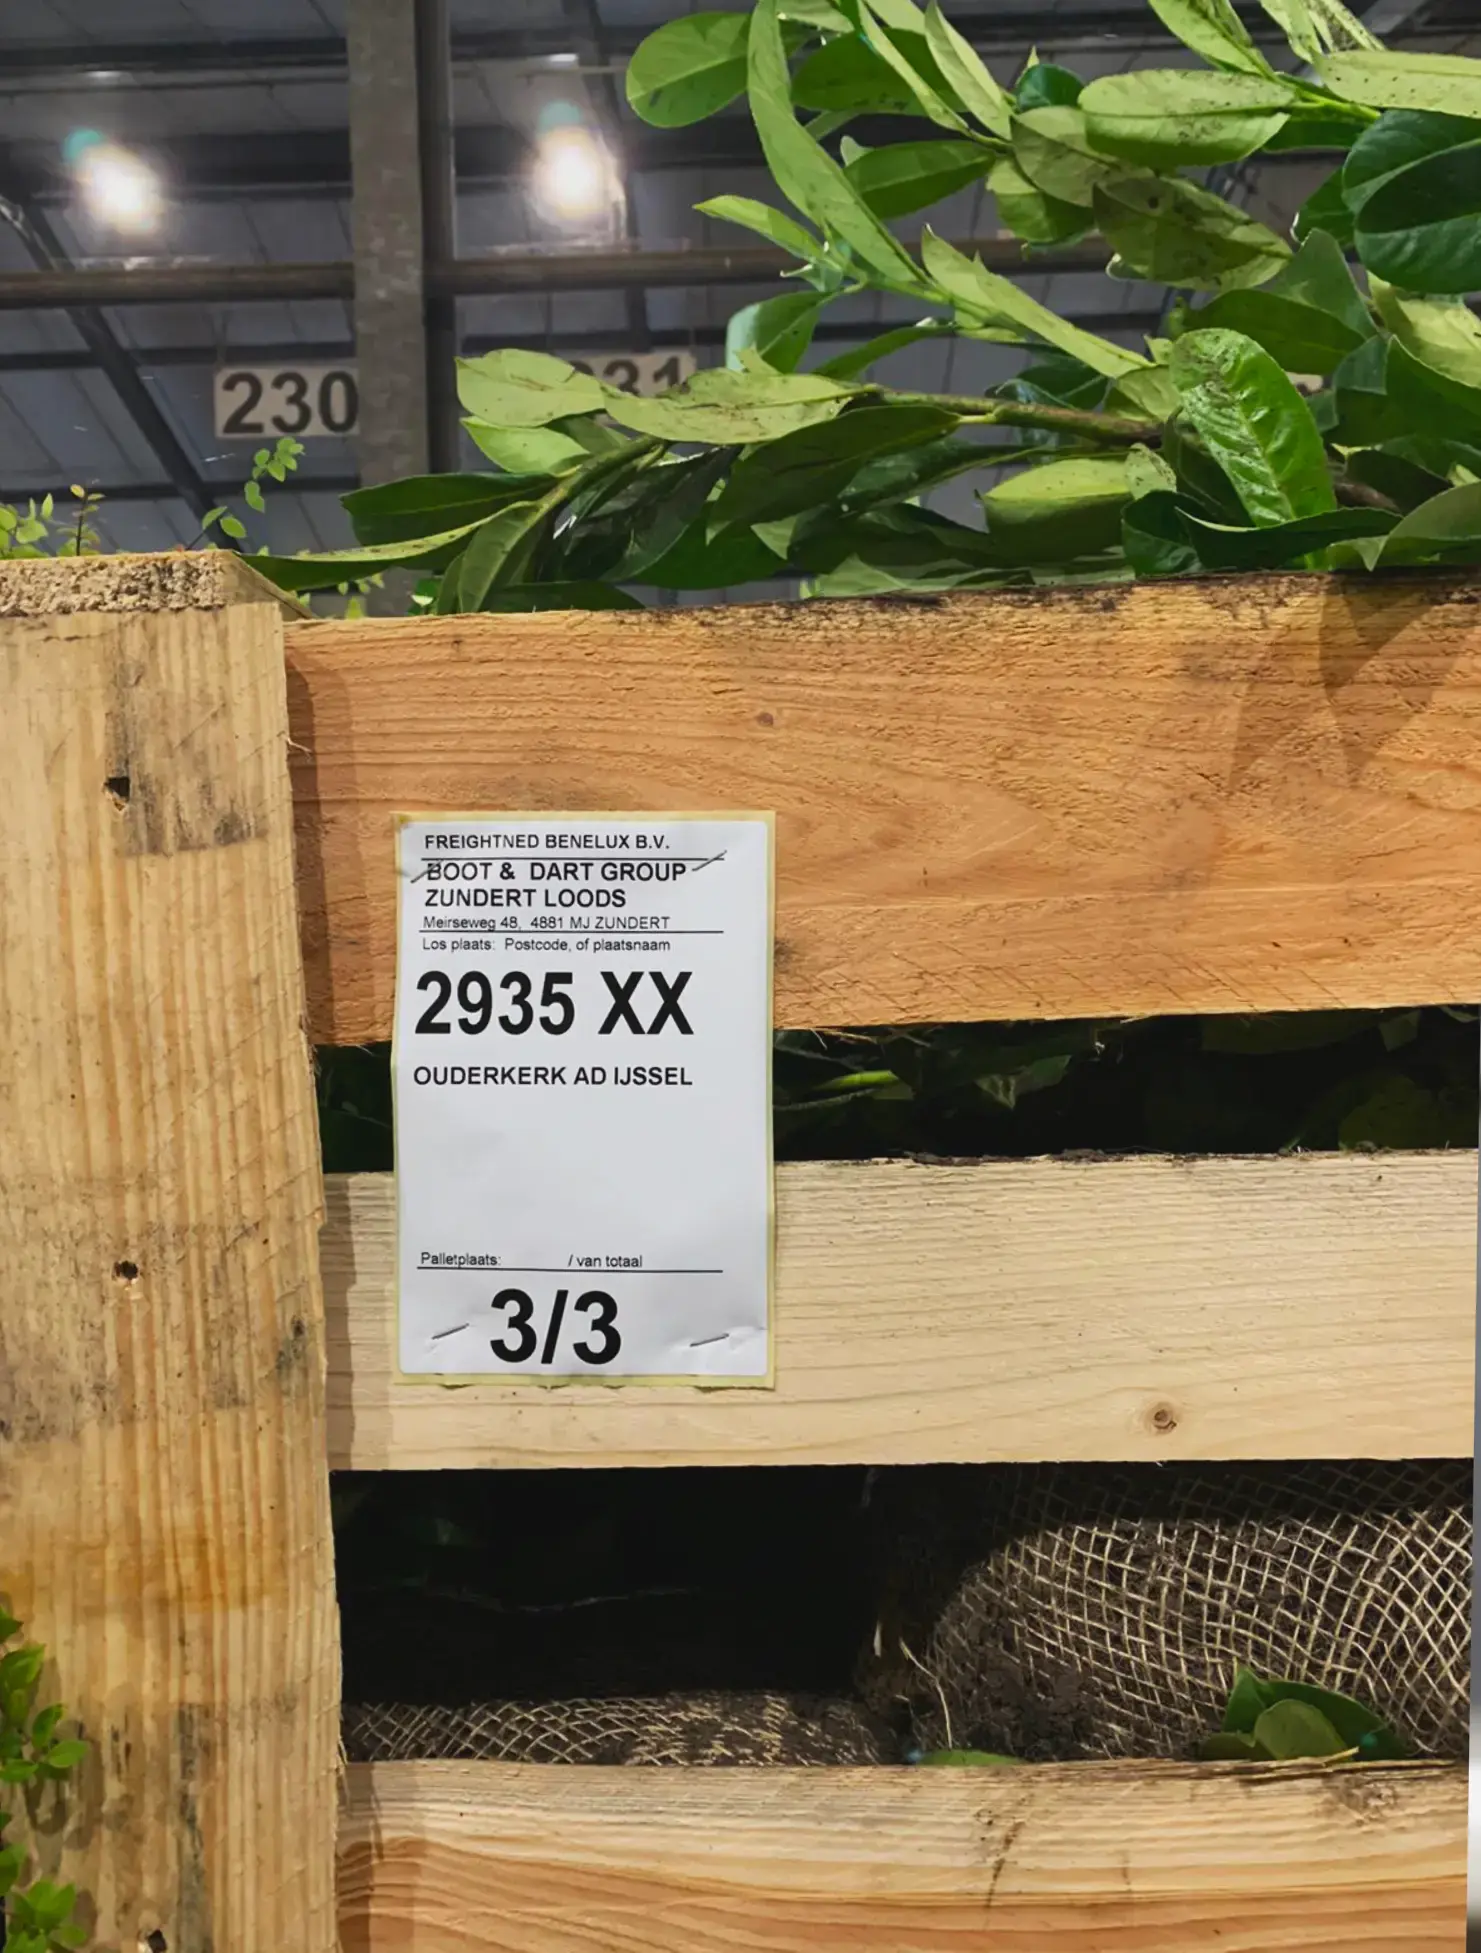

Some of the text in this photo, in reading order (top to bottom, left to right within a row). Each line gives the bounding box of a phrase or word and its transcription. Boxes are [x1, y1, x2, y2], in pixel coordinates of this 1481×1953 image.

[568, 356, 681, 397] 31
[222, 371, 359, 433] 230
[424, 834, 670, 849] FREIGHTNED BENELUX B.V.
[426, 862, 686, 882] BOOT & DART GROUP
[425, 888, 627, 908] ZUNDERT LOODS
[423, 916, 670, 932] Meirseweg 48, 4881 MJ ZUNDERT
[422, 937, 671, 954] Los plaats: Postcode, of plaatsnaam
[415, 970, 695, 1035] 2935 XX
[413, 1066, 693, 1086] OUDERKERK AD IJSSEL
[420, 1251, 501, 1268] Palletplaats:
[576, 1257, 602, 1268] van
[605, 1254, 643, 1269] totaal
[489, 1287, 622, 1365] 3/3
